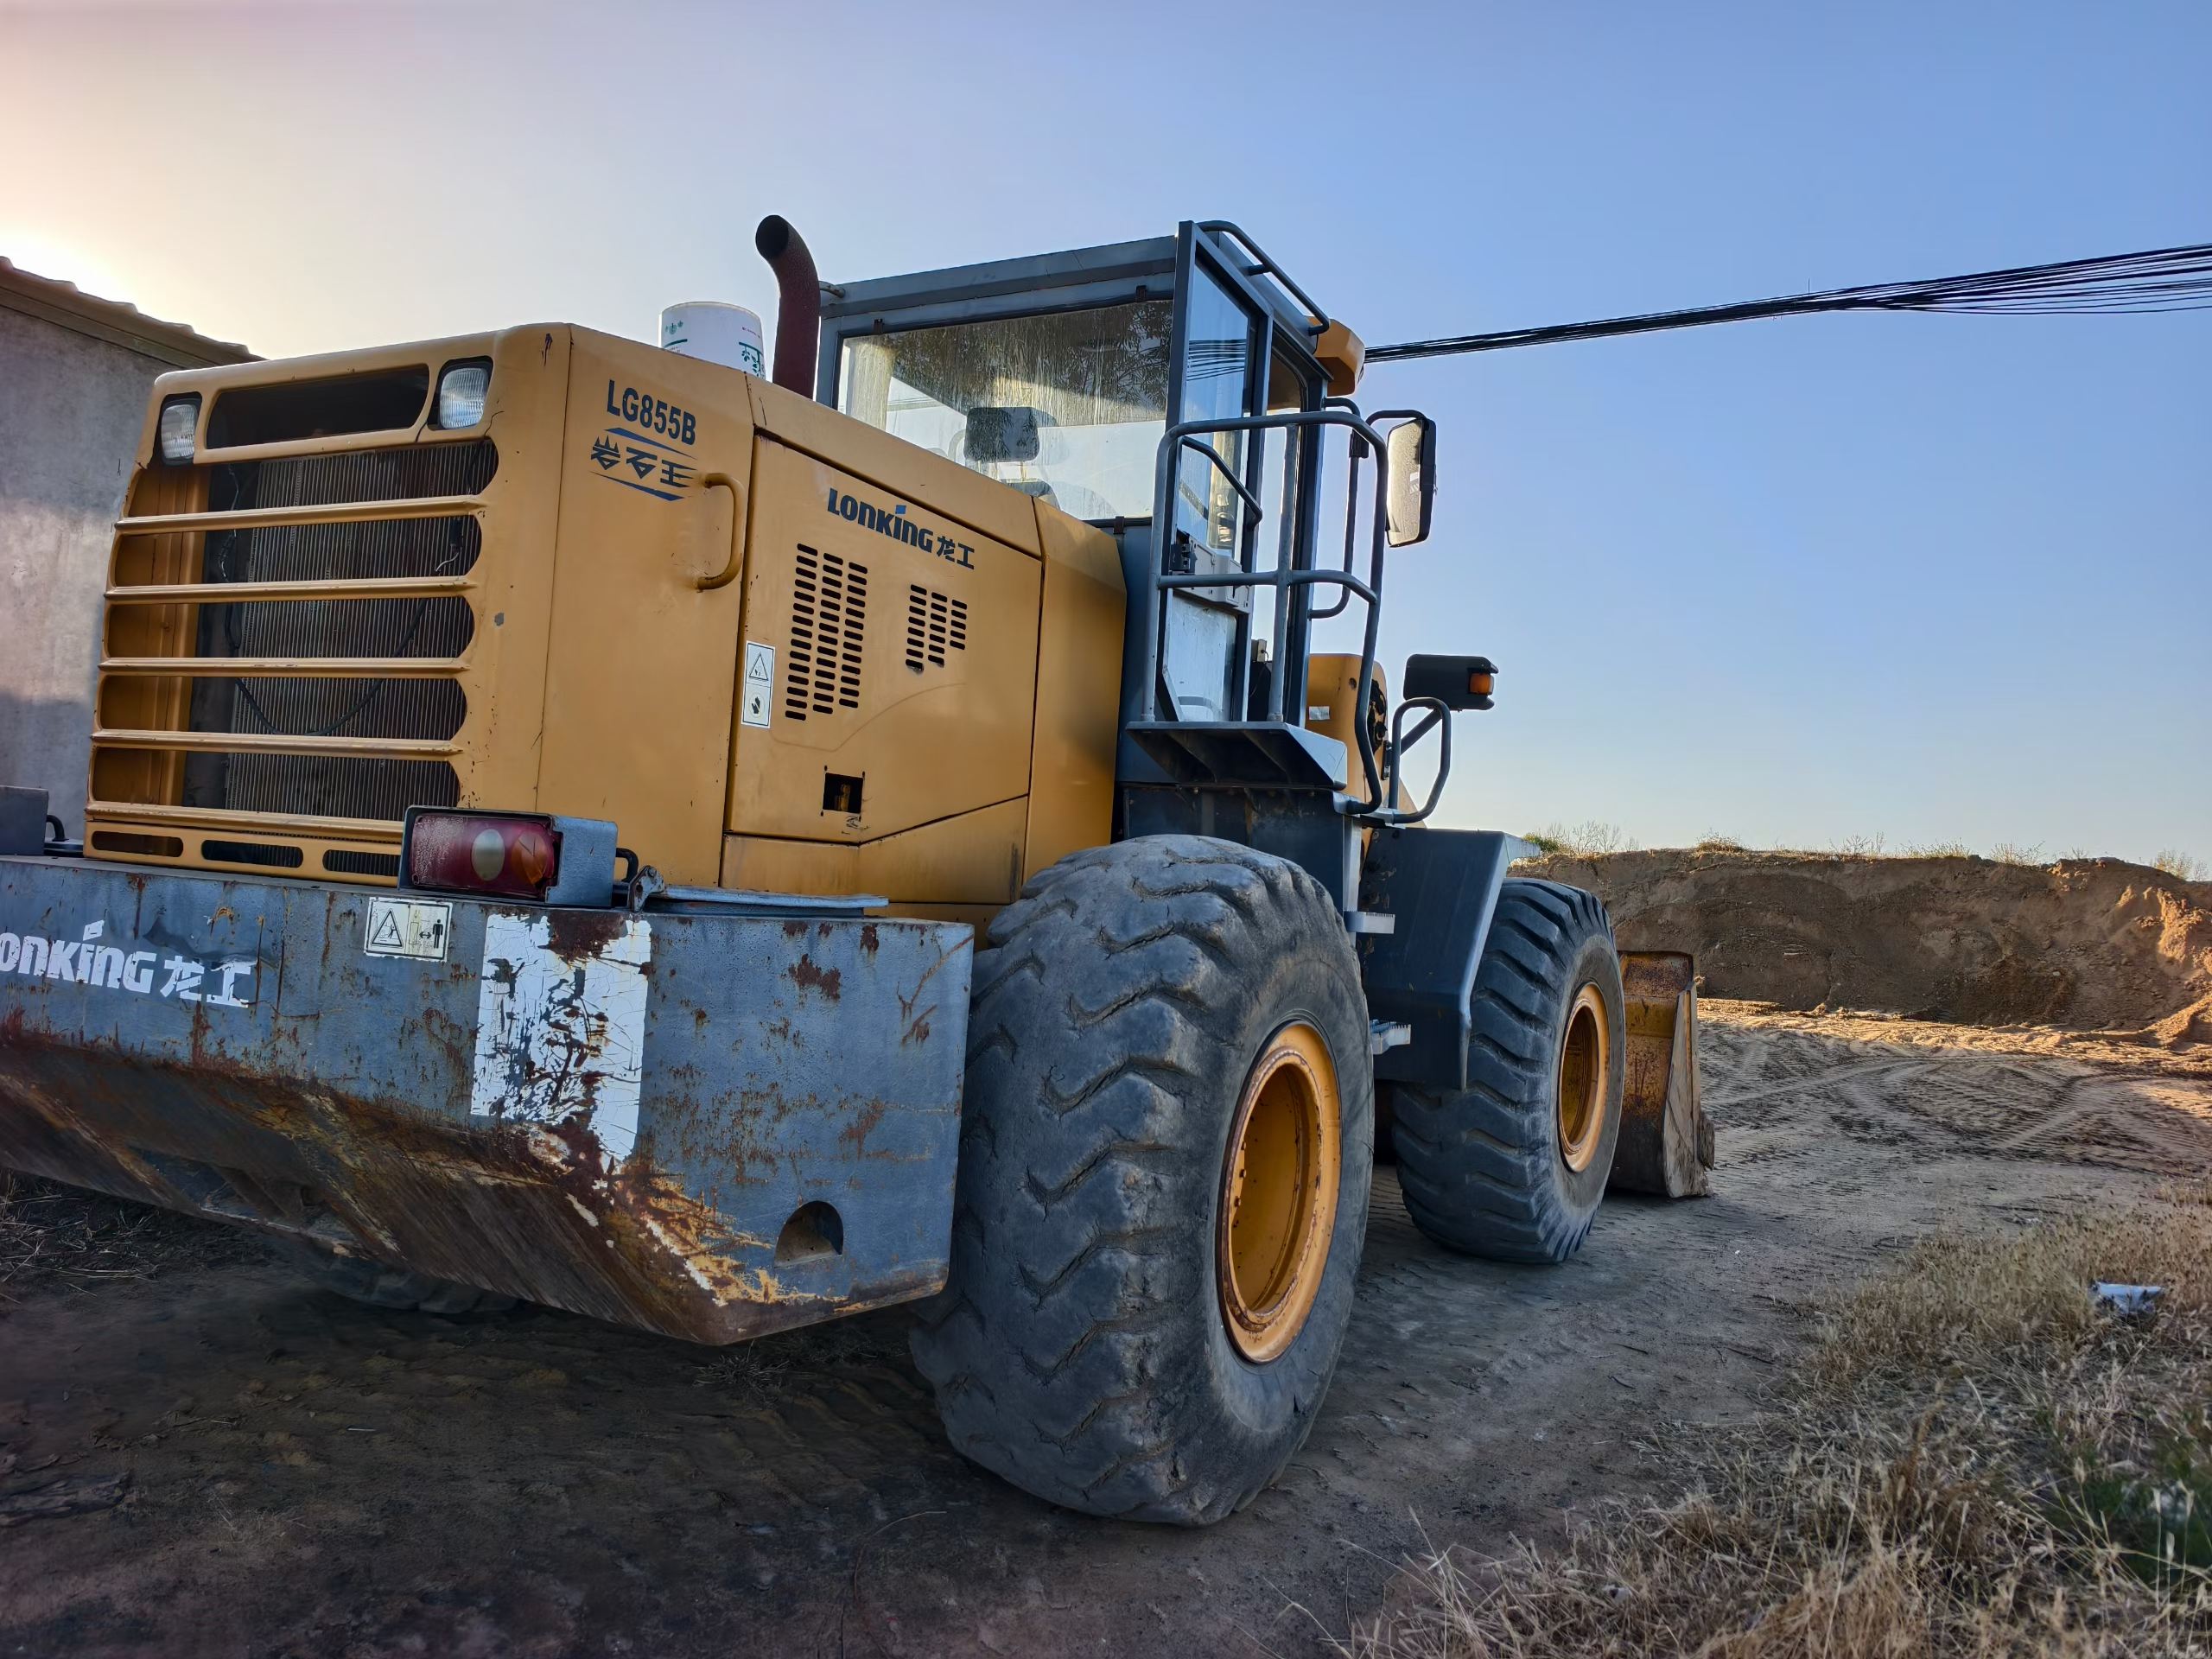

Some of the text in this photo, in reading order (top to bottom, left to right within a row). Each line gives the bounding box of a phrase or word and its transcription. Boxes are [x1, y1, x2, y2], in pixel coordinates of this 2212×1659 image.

[607, 378, 696, 446] LG855B
[936, 535, 975, 570] 龙工
[160, 955, 251, 1007] 龙工
